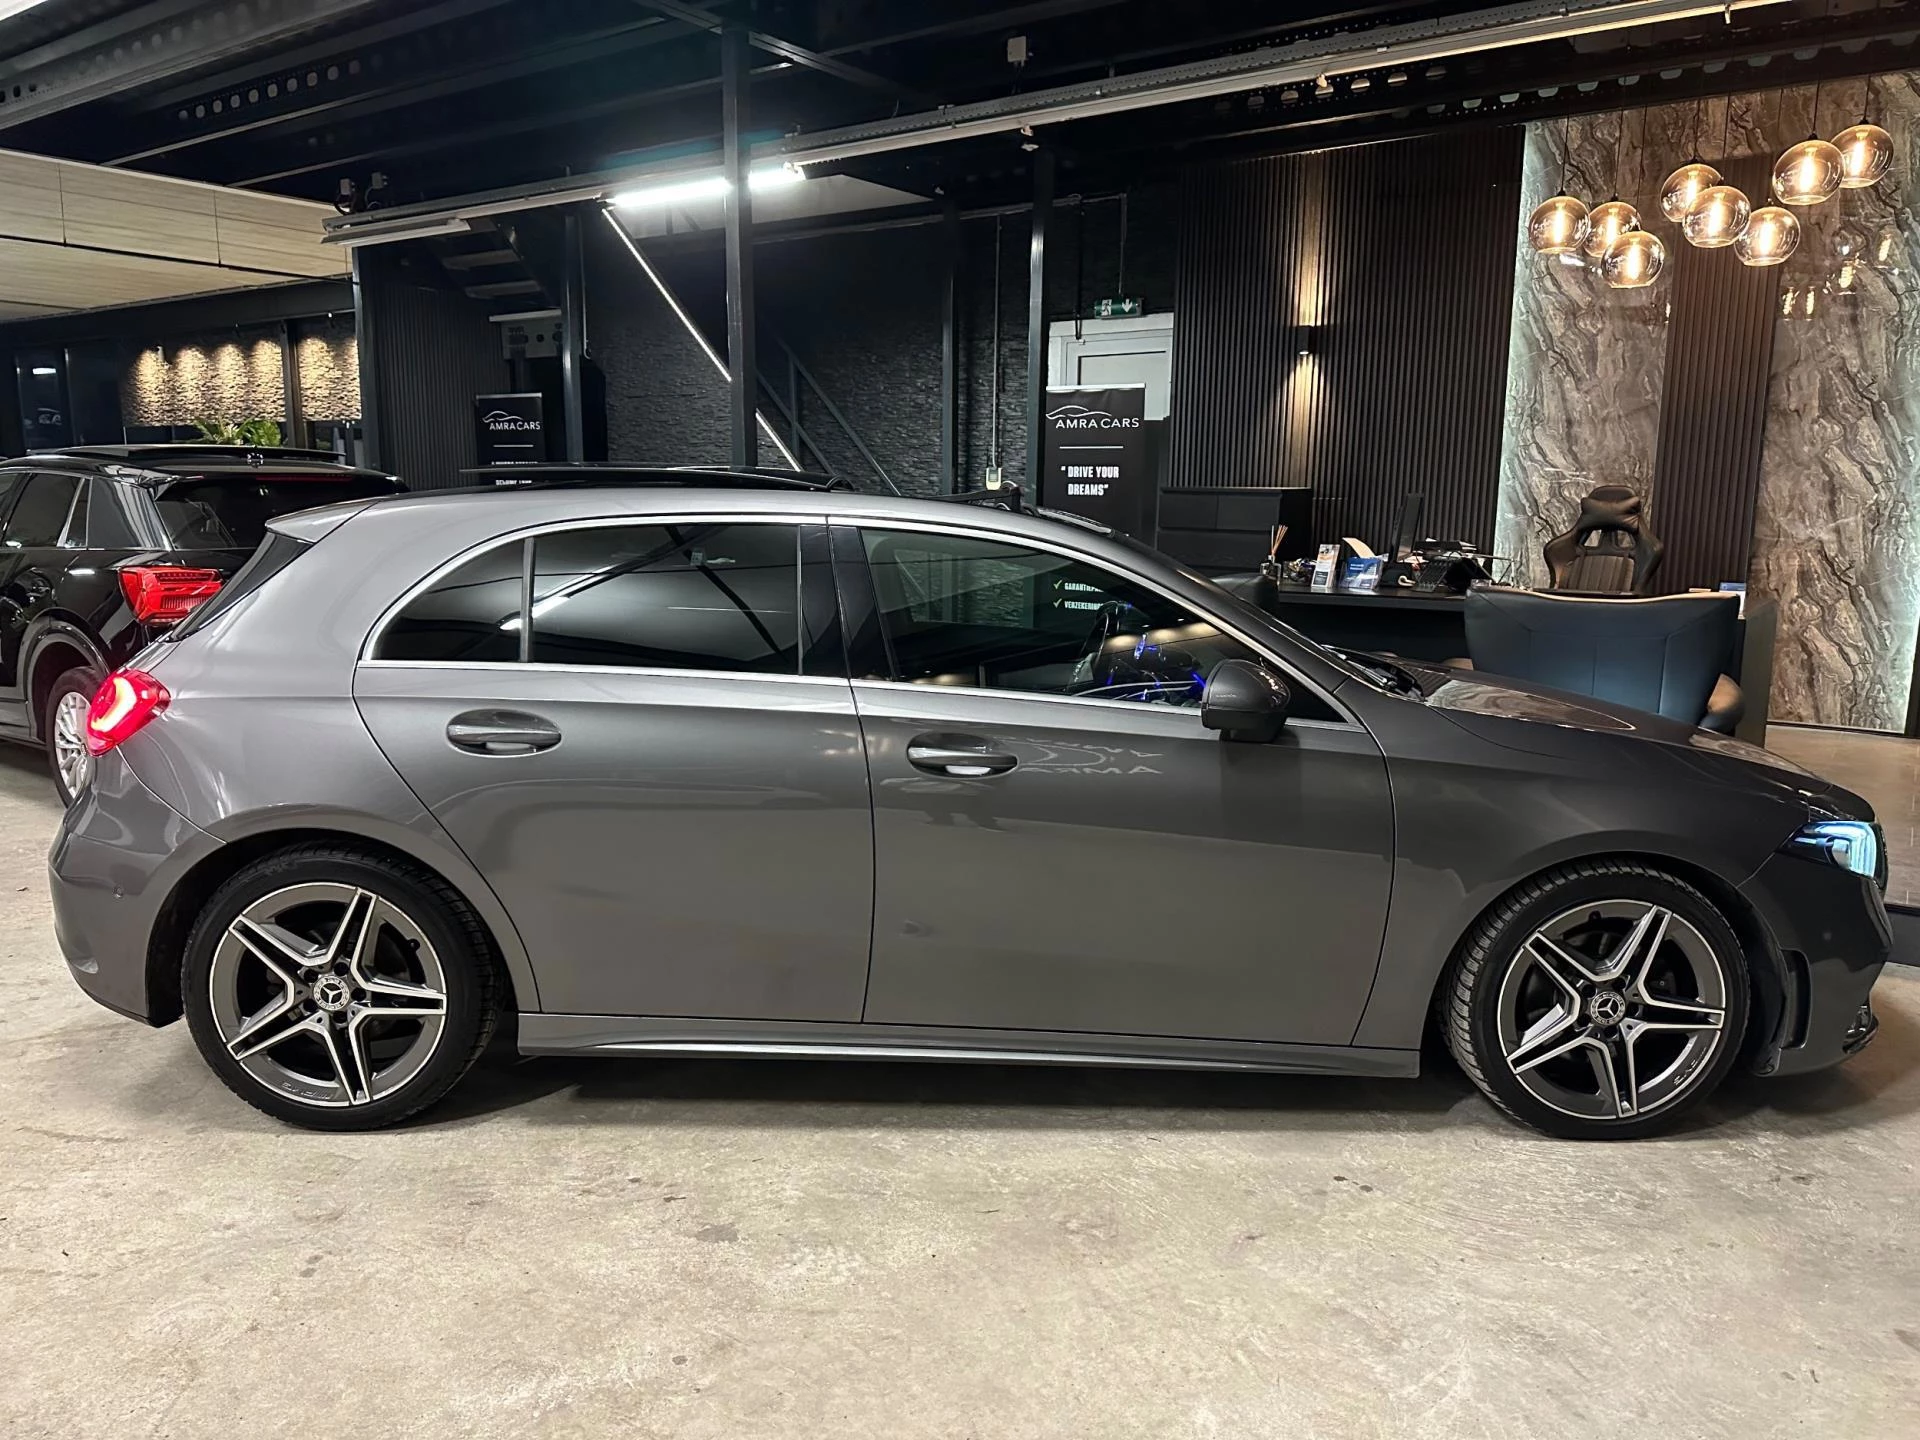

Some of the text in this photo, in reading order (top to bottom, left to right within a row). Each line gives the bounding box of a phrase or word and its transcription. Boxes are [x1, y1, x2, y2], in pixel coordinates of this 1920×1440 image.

[489, 421, 541, 430] AMRA CARS
[1055, 417, 1140, 429] AMRA CARS
[1095, 466, 1120, 478] YOUR
